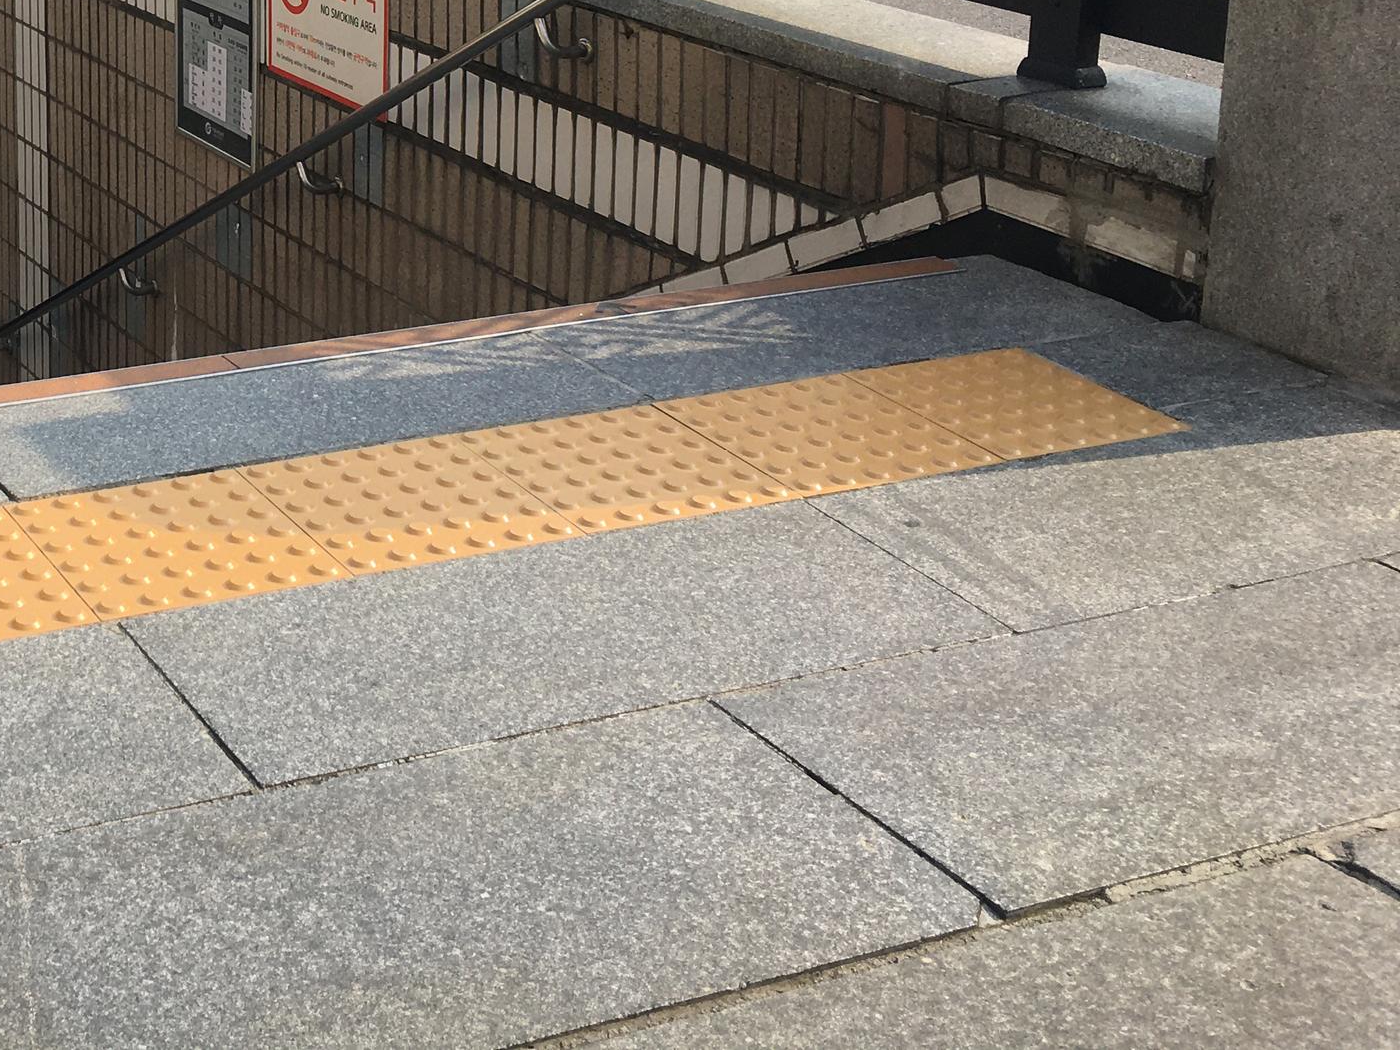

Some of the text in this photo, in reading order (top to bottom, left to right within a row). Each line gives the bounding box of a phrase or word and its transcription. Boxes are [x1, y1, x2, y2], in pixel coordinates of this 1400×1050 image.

[320, 4, 377, 35] NO SMOKING AREA
